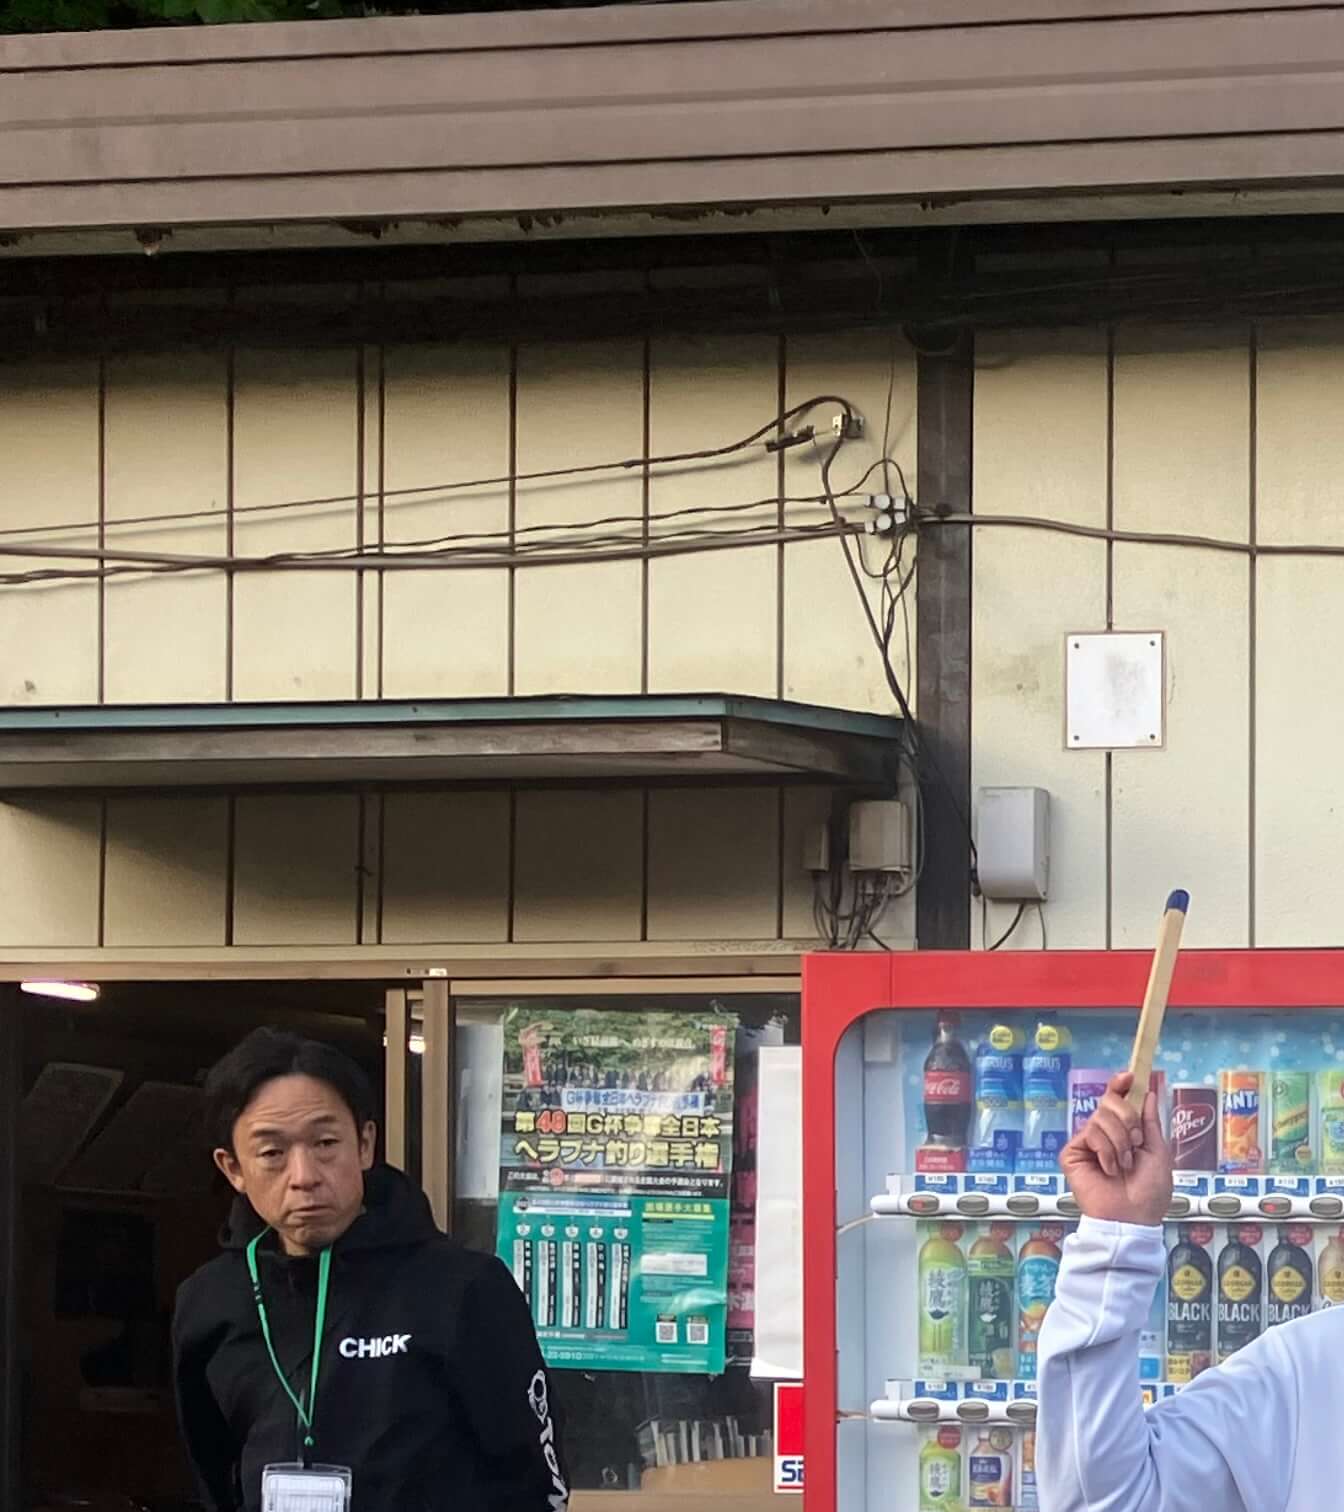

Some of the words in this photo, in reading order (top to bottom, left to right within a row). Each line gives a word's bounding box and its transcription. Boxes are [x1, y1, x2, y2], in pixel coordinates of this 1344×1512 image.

[1169, 1302, 1211, 1321] BLACK
[1218, 1303, 1260, 1322] BLACK
[338, 1334, 412, 1358] CHICK
